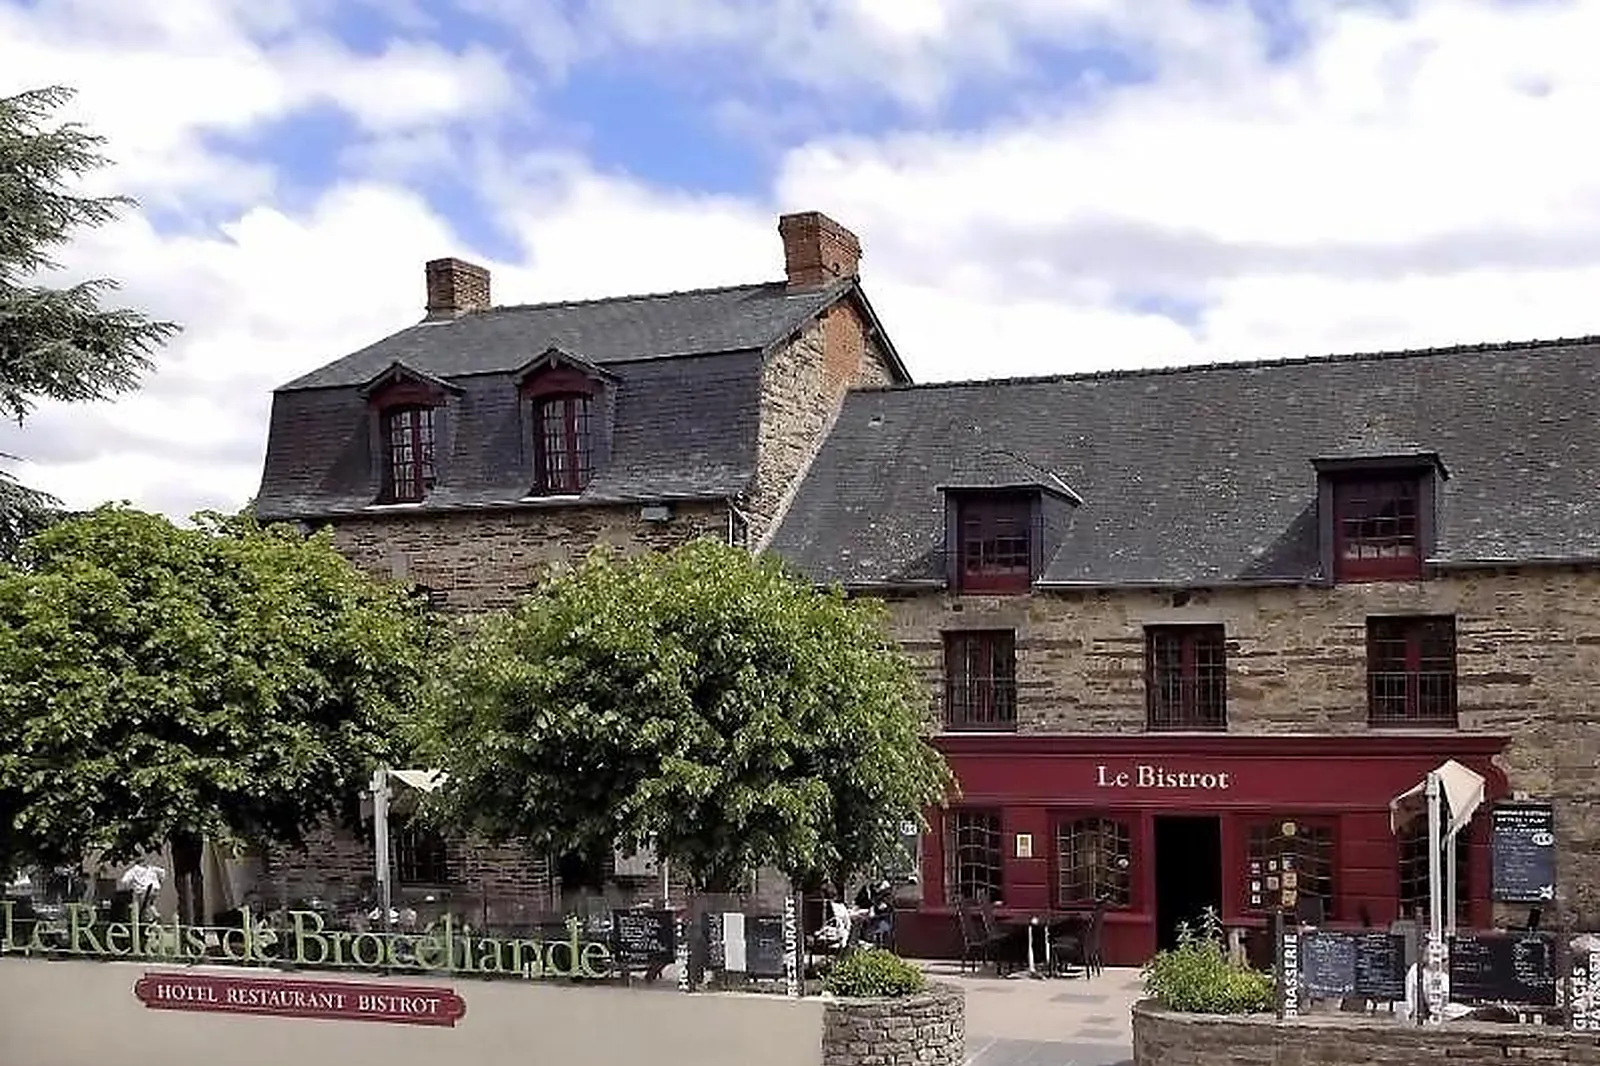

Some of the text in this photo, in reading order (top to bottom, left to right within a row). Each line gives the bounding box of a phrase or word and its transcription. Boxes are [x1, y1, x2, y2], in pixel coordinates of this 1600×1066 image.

[1096, 765, 1229, 789] Le Bistrot
[3, 899, 57, 952] Le
[66, 898, 207, 959] Relais
[222, 905, 281, 962] de
[289, 909, 612, 978] Brocéliande
[676, 943, 689, 991] HOTEL
[785, 896, 798, 997] RESTAURANT
[157, 983, 441, 1014] HOTEL RESTAURANT BISTROT
[1284, 934, 1297, 1018] BRASSERIE
[1573, 967, 1586, 1030] GLACES
